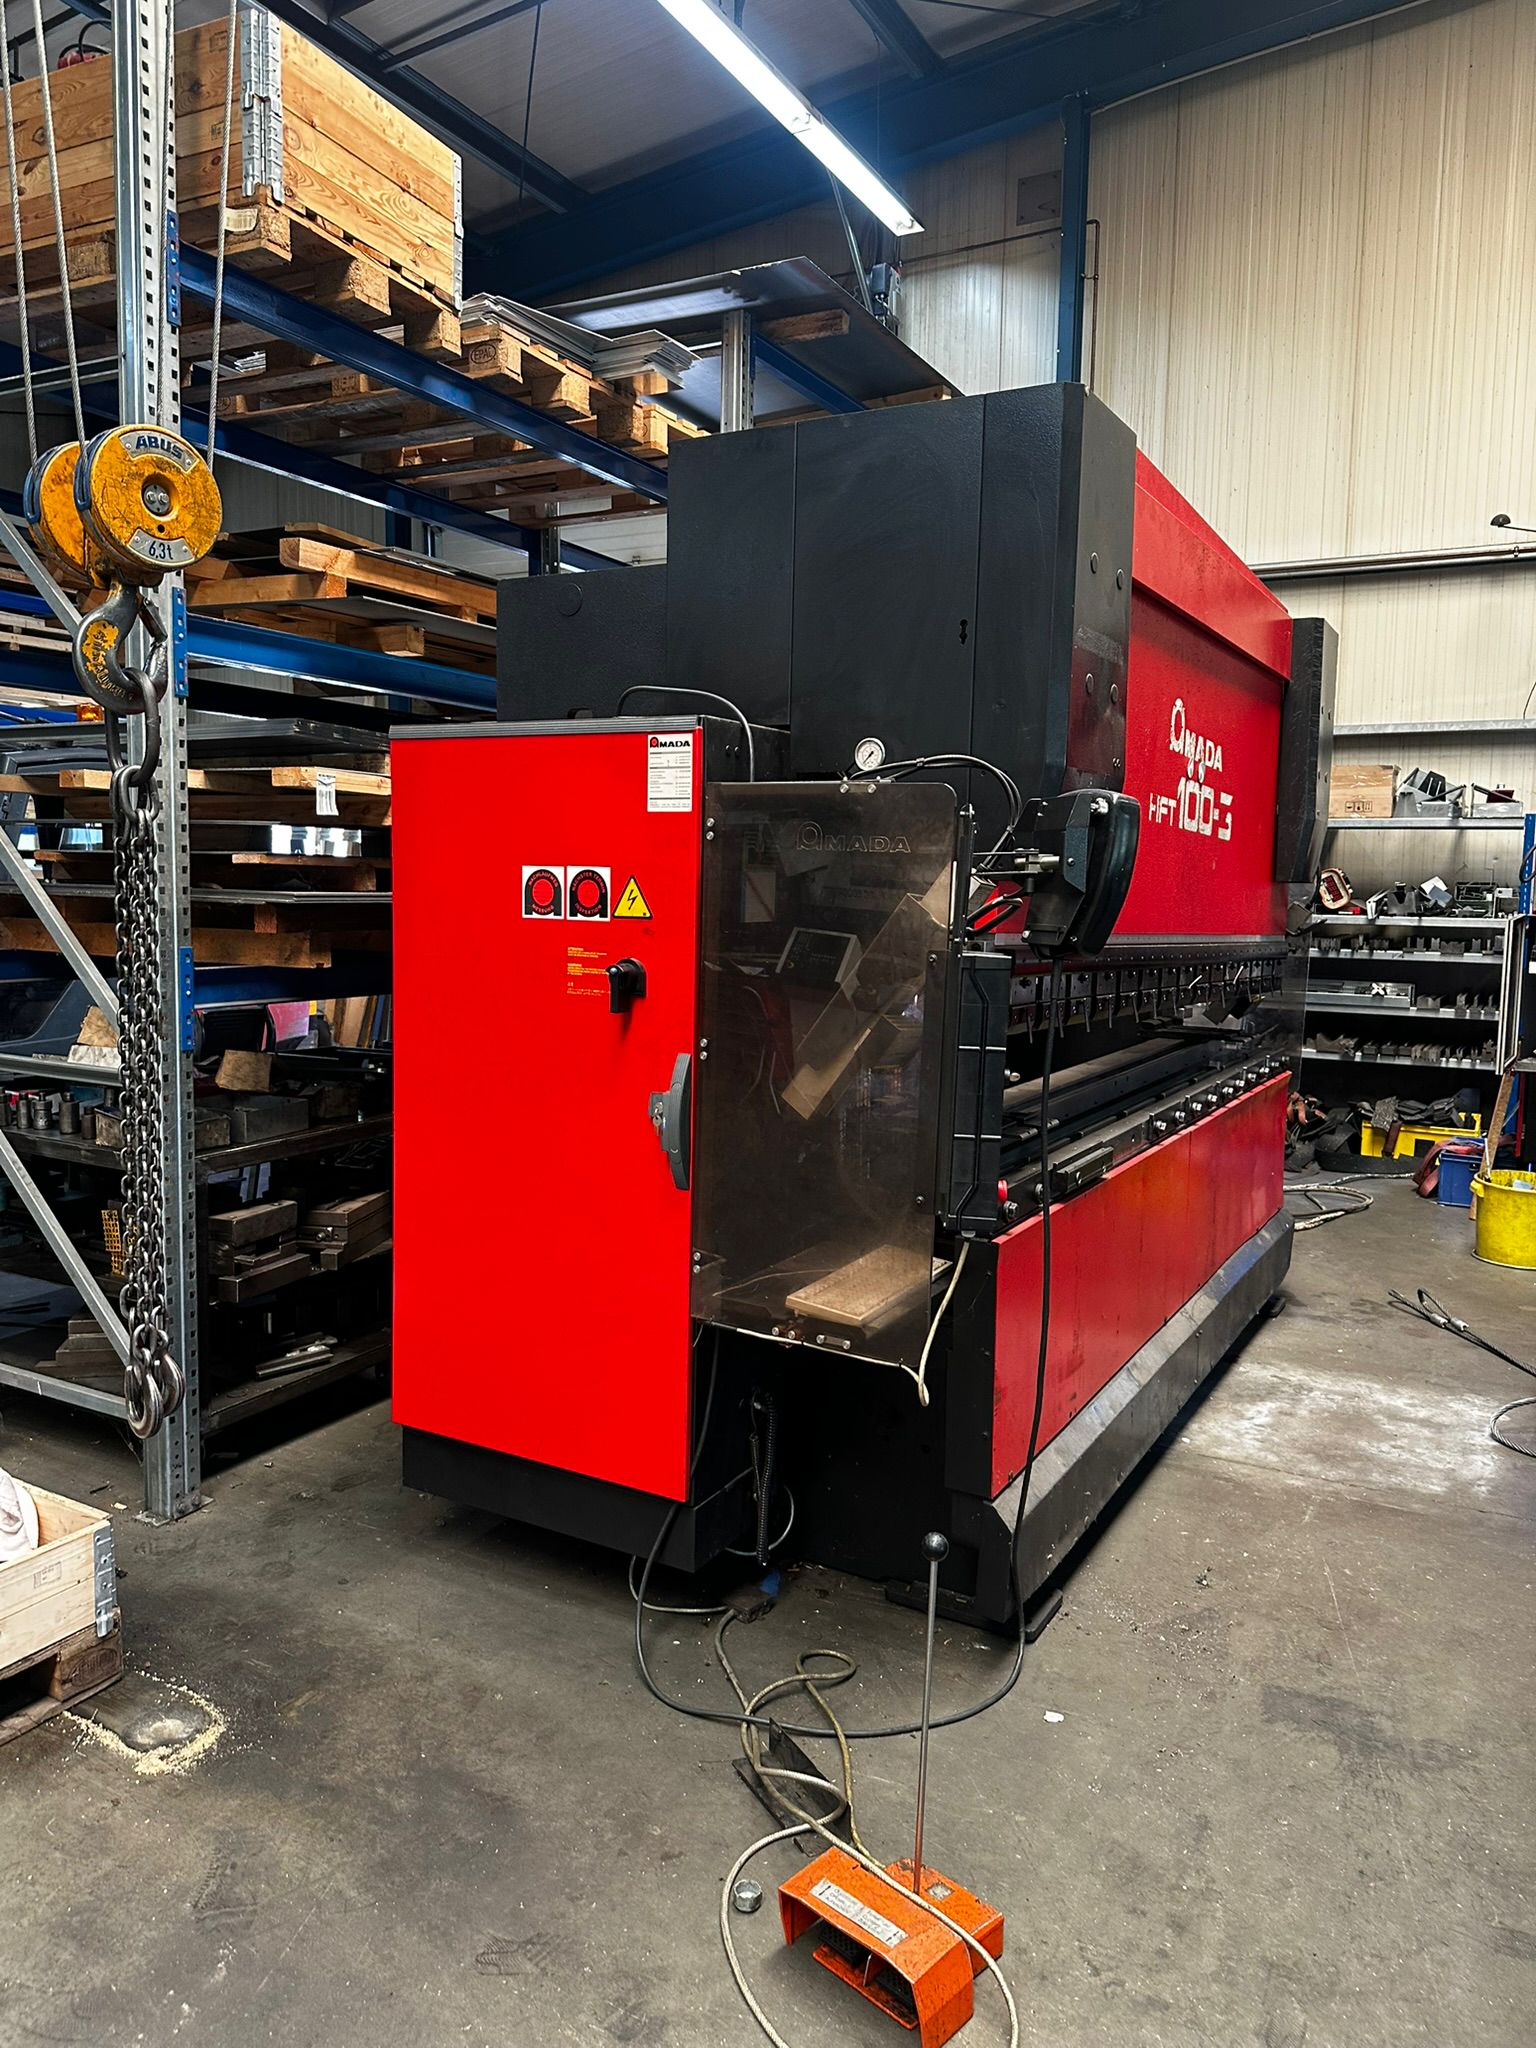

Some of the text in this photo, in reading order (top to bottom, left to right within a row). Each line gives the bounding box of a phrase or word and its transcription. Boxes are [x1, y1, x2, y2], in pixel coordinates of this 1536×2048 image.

[136, 435, 183, 459] ABUS
[649, 736, 691, 748] AMADA
[1169, 698, 1223, 772] AMADA
[796, 820, 912, 853] AMADA
